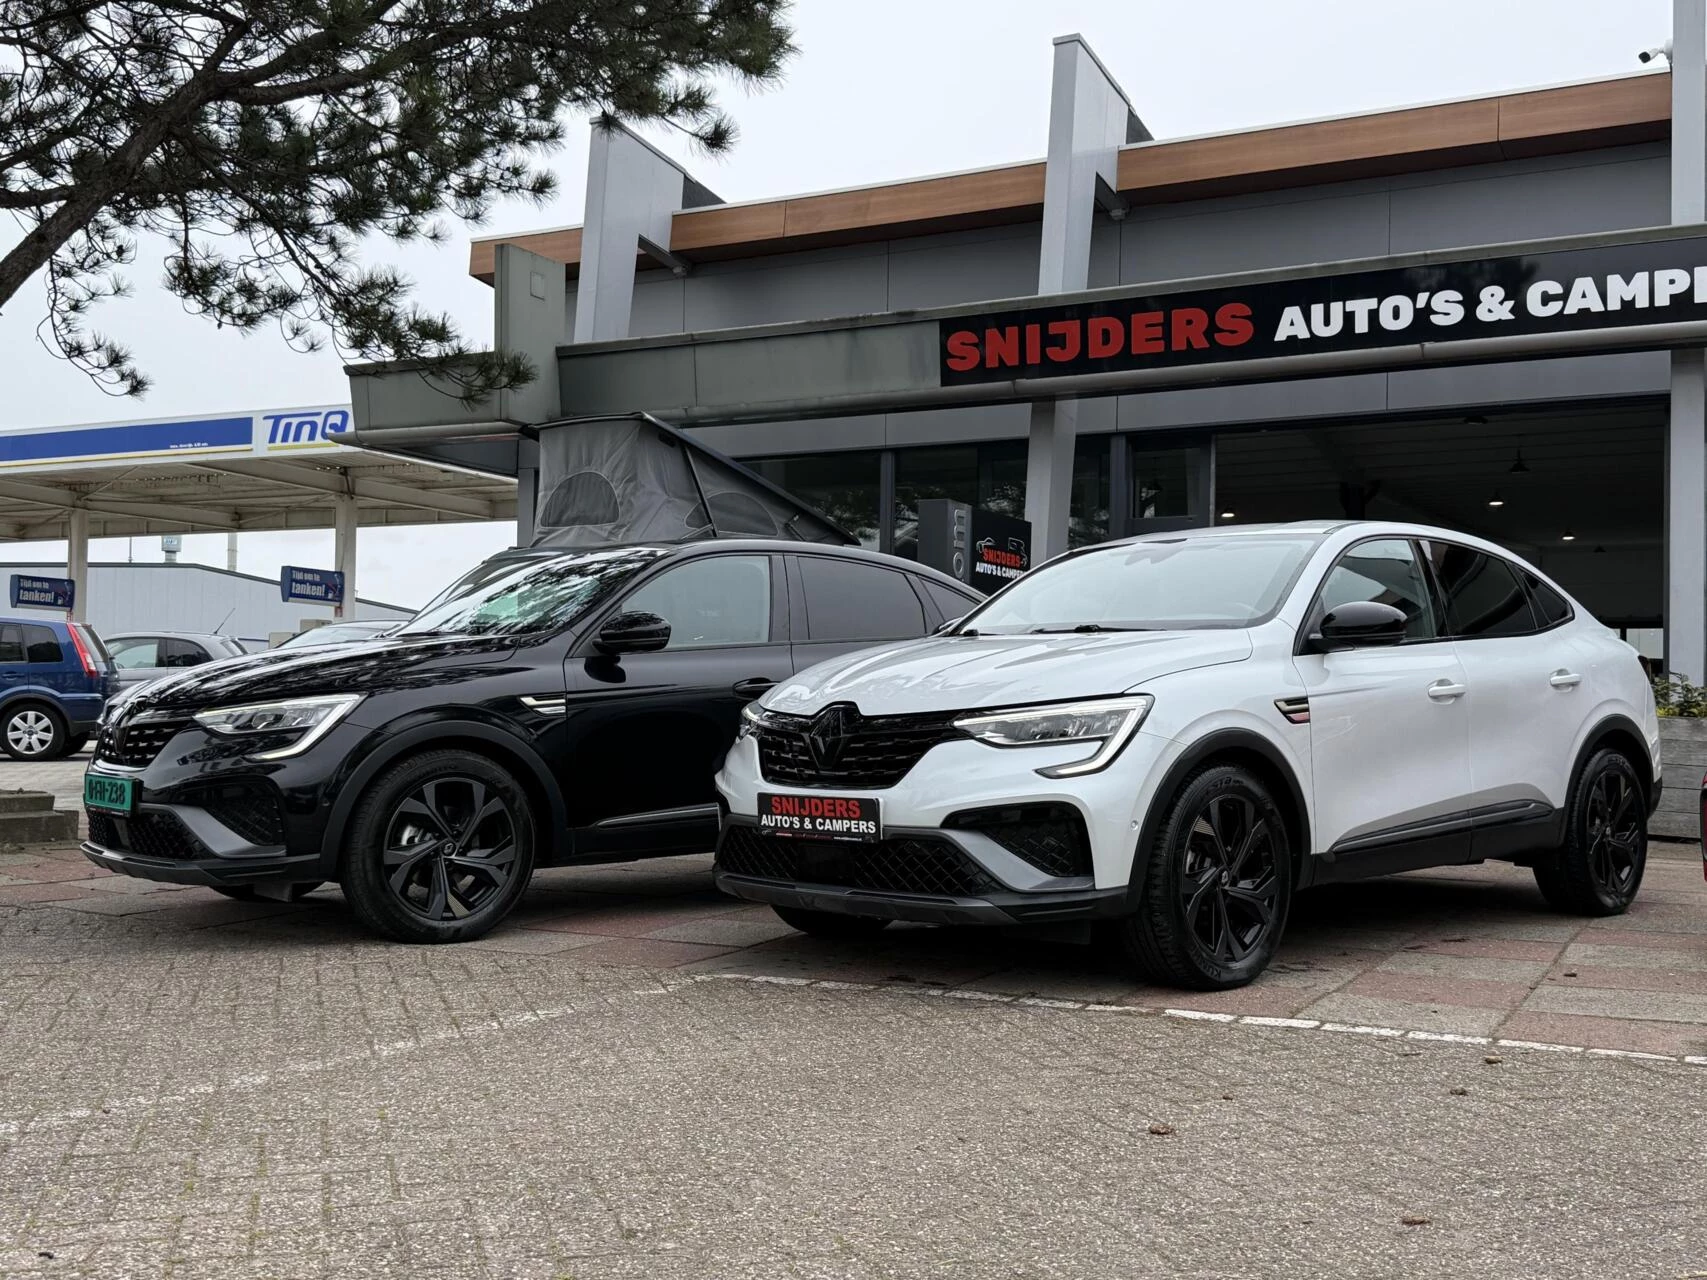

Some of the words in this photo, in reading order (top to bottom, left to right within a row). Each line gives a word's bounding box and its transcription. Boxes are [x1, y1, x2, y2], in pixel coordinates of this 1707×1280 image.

[945, 302, 1255, 372] SNIJDERS
[1273, 289, 1465, 342] AUTO'S
[1475, 285, 1516, 323] &
[982, 547, 1021, 568] SNIJDERS
[975, 561, 997, 576] AUTO'S
[997, 564, 1003, 577] &
[19, 590, 55, 602] tanken!
[291, 582, 325, 596] tanken!
[771, 796, 861, 819] SNIJDERS
[760, 814, 800, 829] AUTO'S
[803, 817, 813, 830] &
[815, 818, 876, 834] CAMPERS
